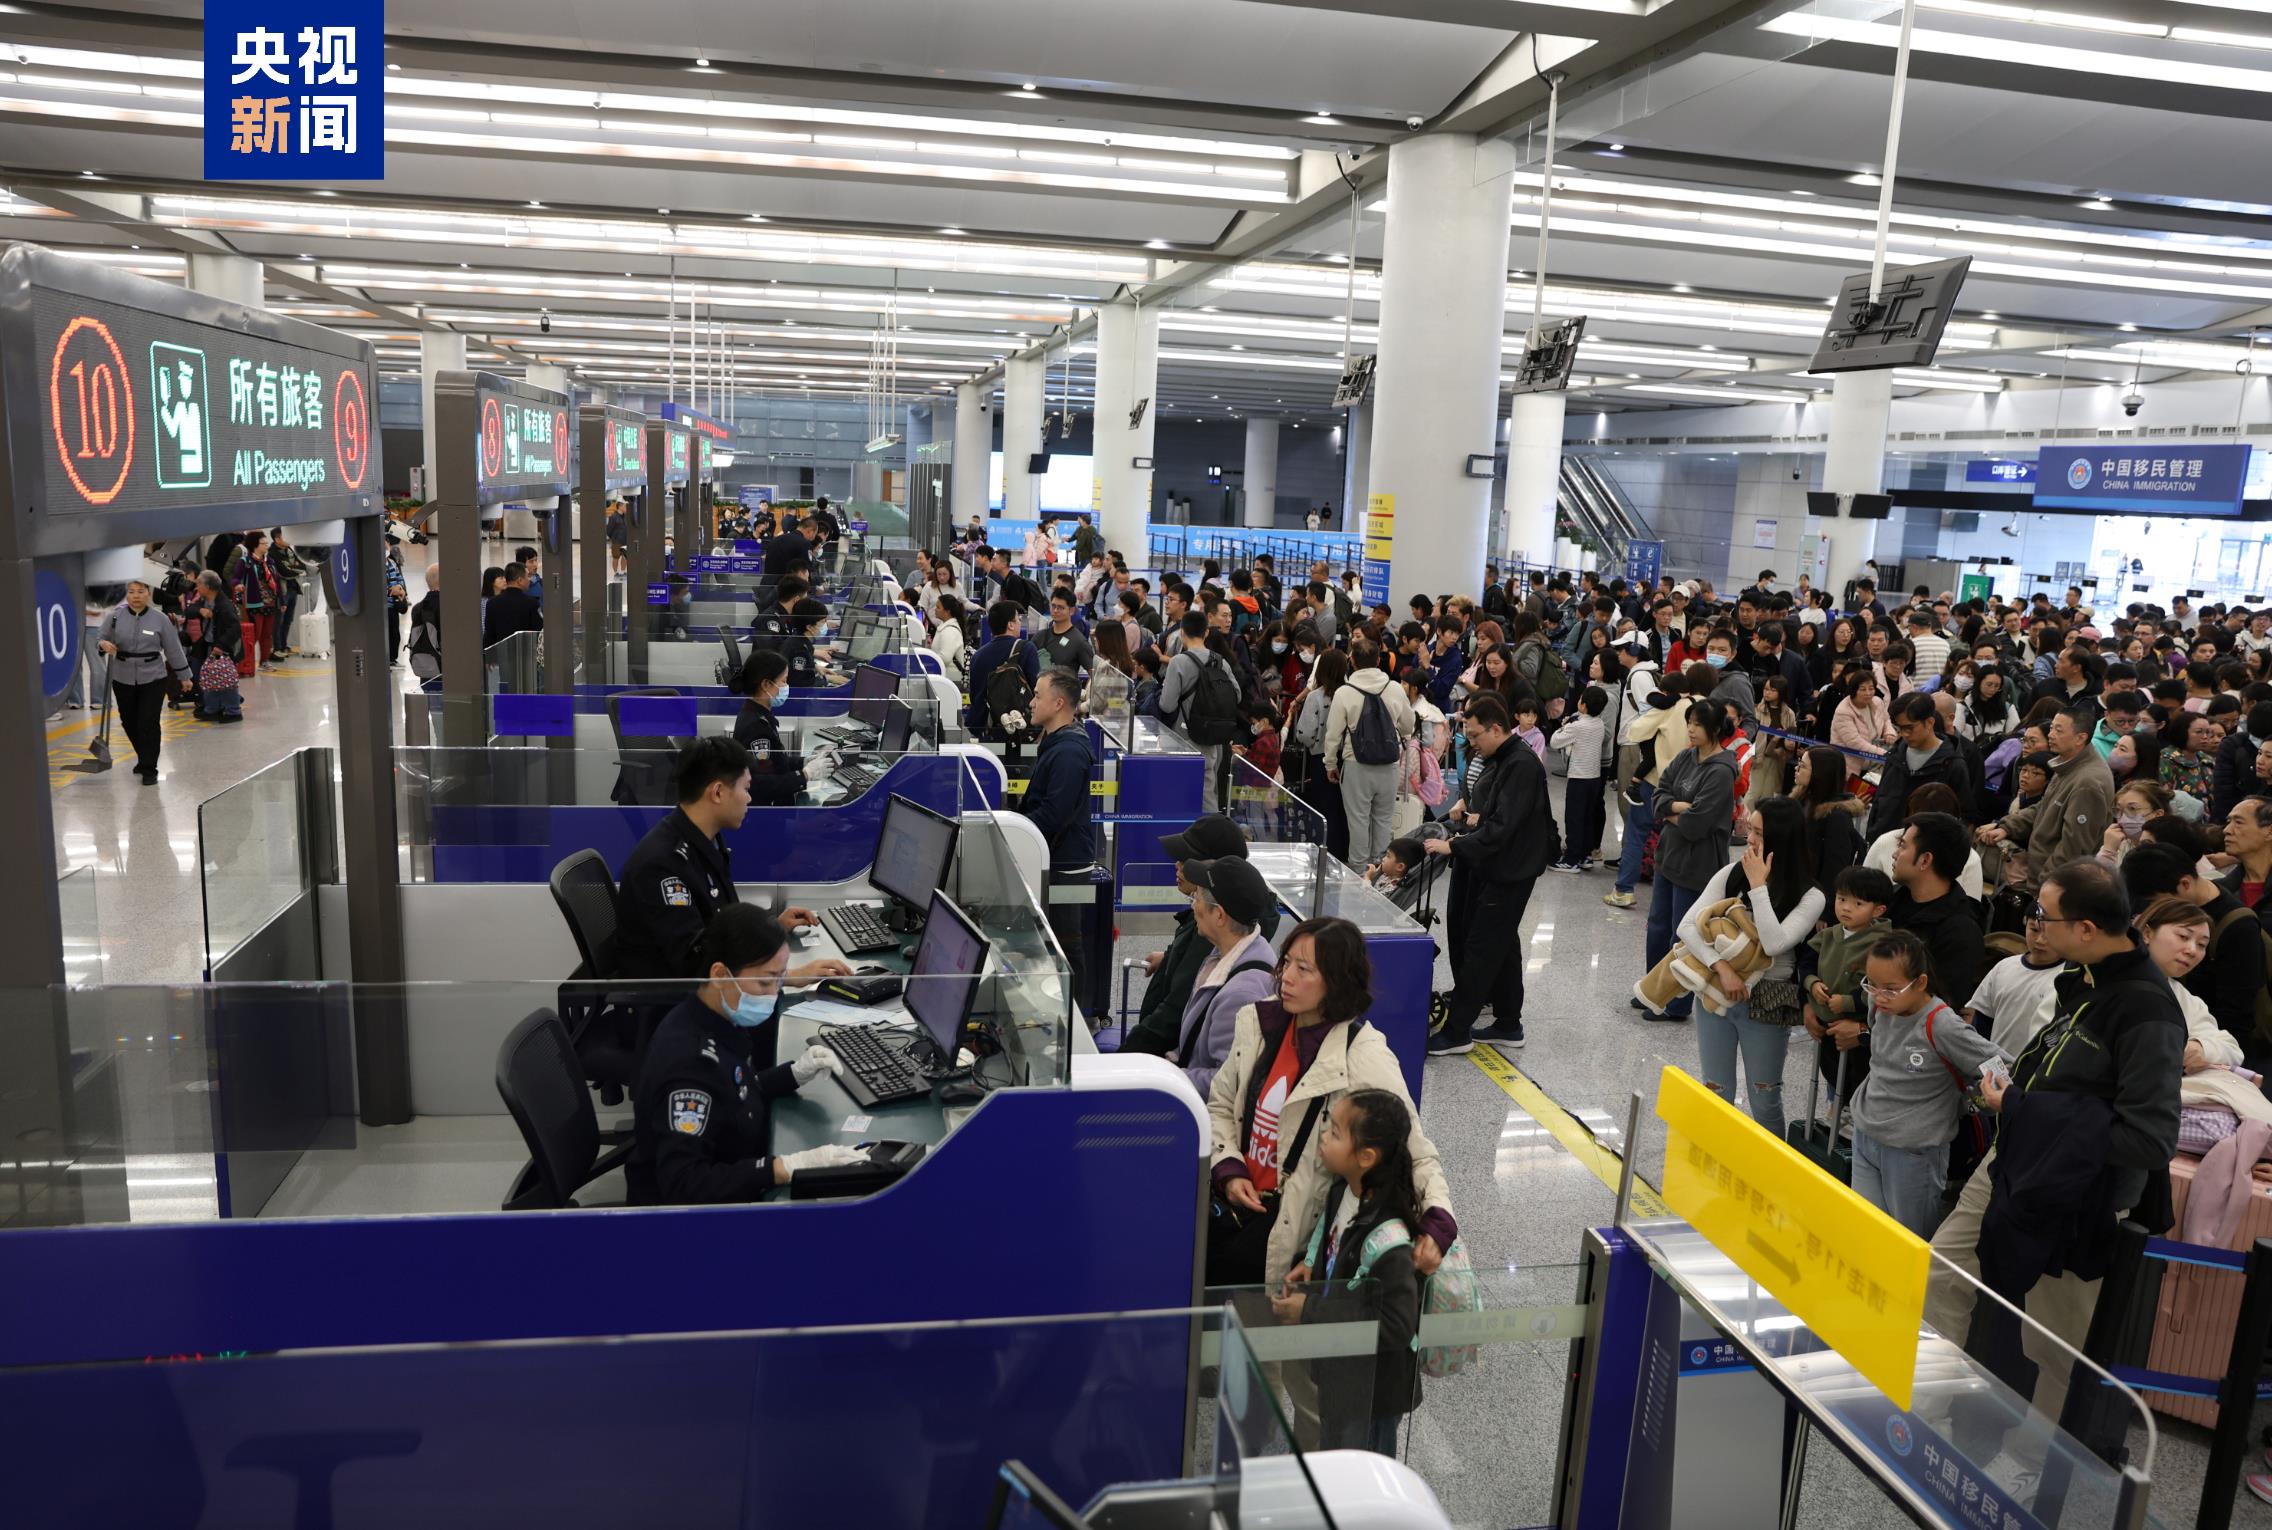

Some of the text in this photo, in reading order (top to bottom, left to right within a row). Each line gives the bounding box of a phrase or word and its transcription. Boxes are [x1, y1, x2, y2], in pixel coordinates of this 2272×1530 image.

[69, 360, 117, 458] 10
[229, 357, 323, 430] 所有旅客
[345, 400, 358, 461] 9
[488, 417, 496, 459] 8
[524, 408, 552, 444] 所有旅客
[233, 449, 325, 491] All Passengers
[2101, 458, 2203, 478] 中国移民管理
[2103, 480, 2196, 492] CHINA IMMIGRATION
[340, 549, 349, 584] 9
[36, 603, 69, 664] 10
[1925, 1470, 1956, 1504] CHINA
